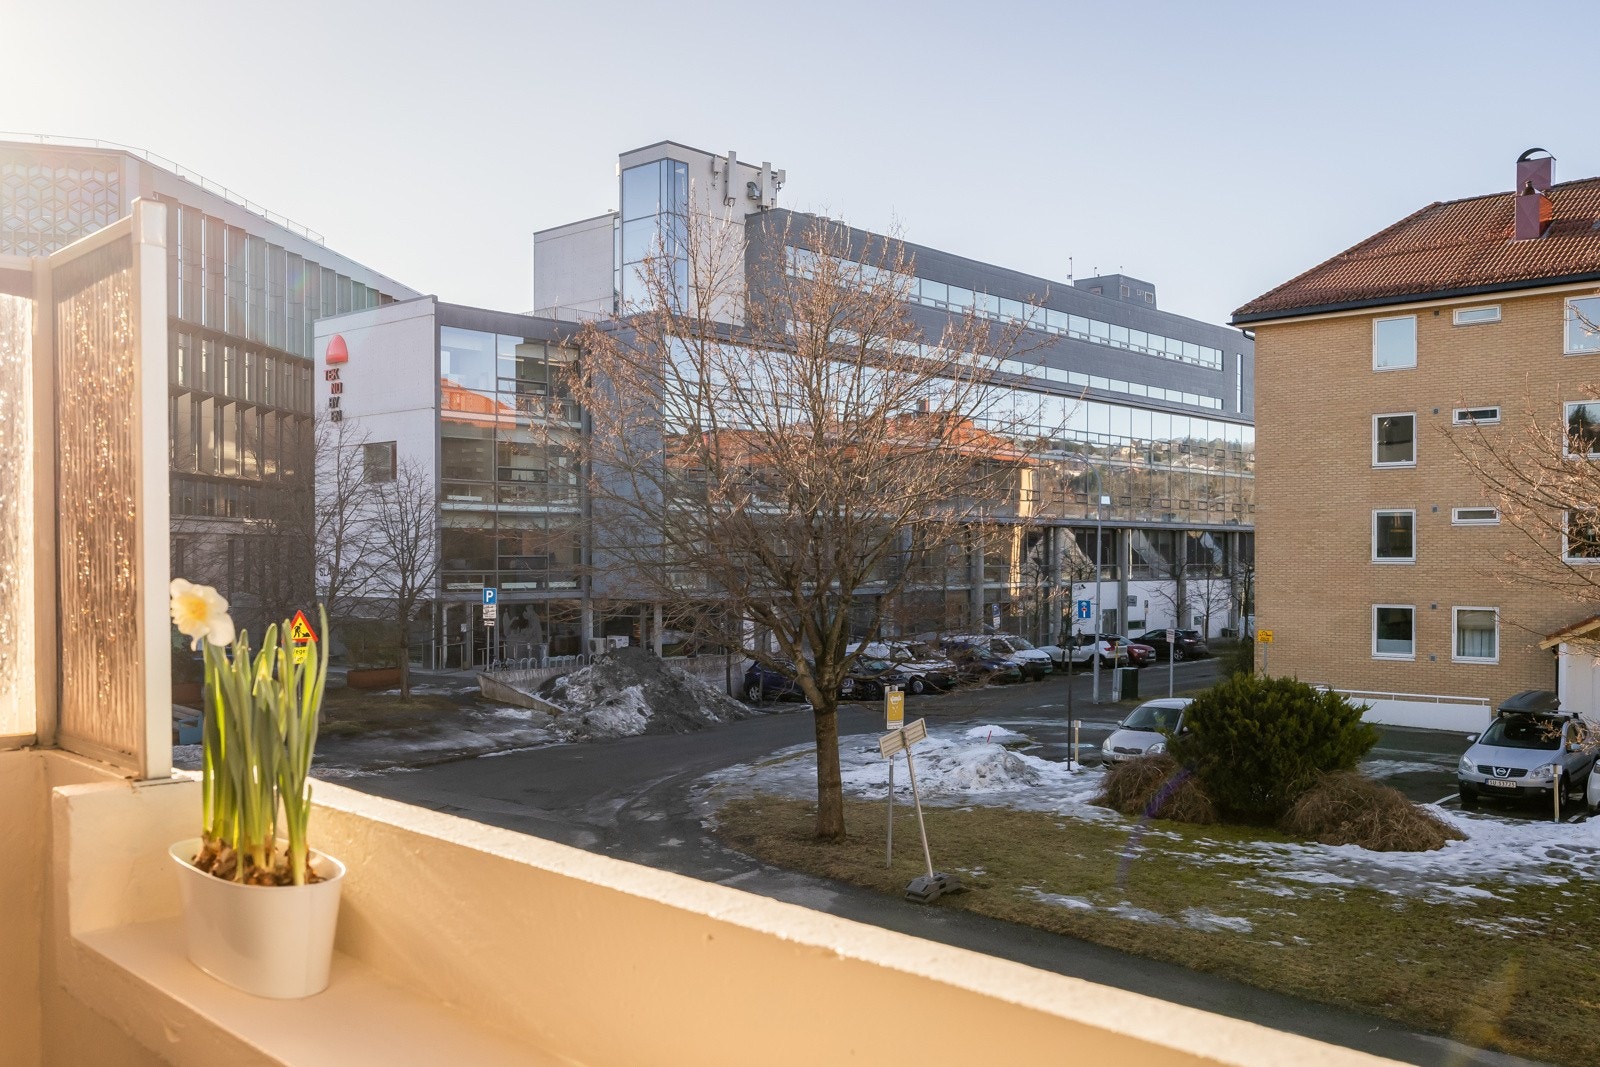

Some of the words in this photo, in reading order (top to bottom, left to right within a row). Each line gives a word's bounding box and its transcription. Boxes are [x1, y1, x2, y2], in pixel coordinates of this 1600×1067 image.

[324, 368, 340, 381] TEK
[331, 382, 343, 394] NO
[329, 397, 340, 409] BY
[331, 410, 342, 422] EN
[486, 590, 494, 603] P
